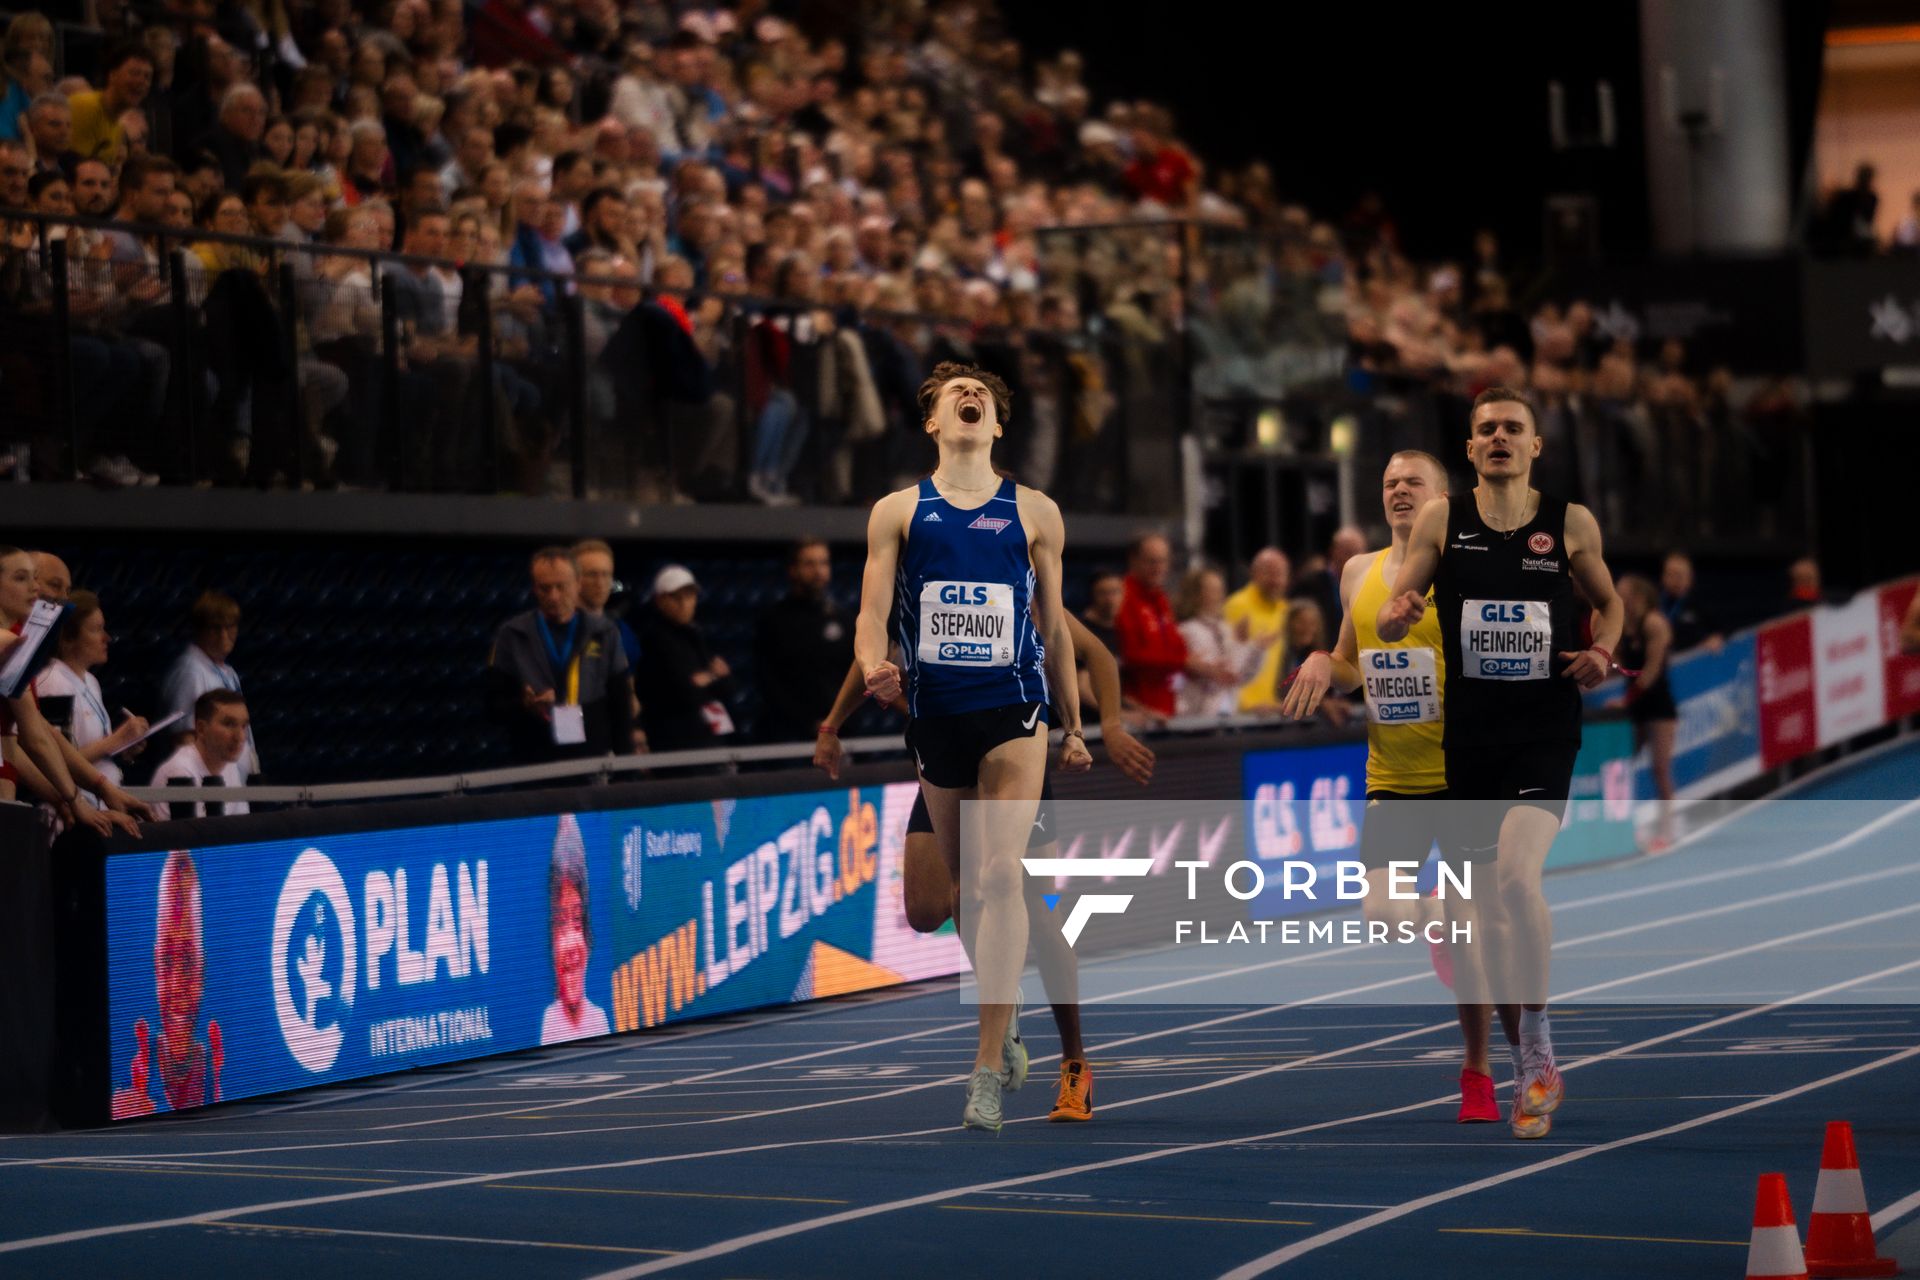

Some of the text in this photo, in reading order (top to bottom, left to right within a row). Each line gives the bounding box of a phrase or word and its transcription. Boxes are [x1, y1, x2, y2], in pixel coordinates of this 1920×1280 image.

[931, 612, 1004, 638] STEPANOV
[960, 645, 990, 656] PLAN
[1470, 630, 1543, 653] HEINRICH
[1500, 661, 1529, 671] PLAN
[1392, 705, 1418, 715] PLAN
[364, 859, 490, 990] PLAN
[370, 1006, 493, 1058] INTERNATIONAL
